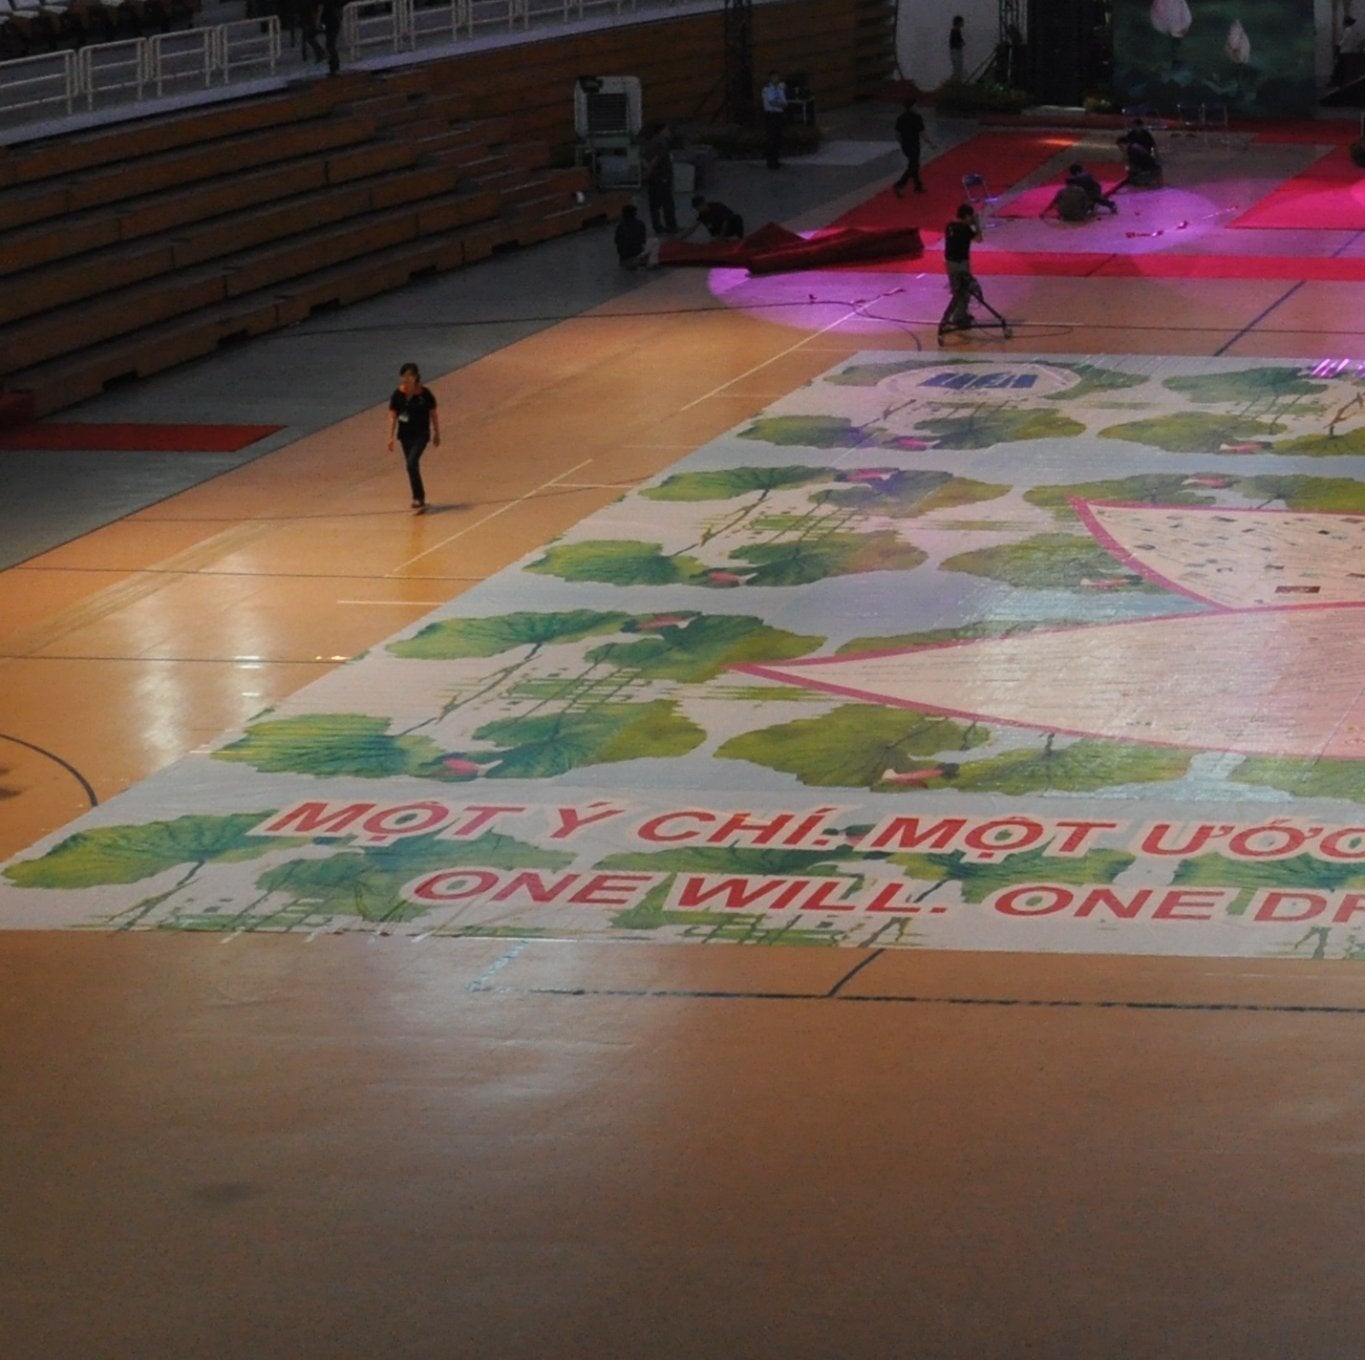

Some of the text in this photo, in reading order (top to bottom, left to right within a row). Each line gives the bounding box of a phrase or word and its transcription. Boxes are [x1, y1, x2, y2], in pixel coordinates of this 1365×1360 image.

[264, 801, 526, 842] MỘT
[550, 801, 625, 839] Ý
[637, 807, 838, 846] CHÍ.
[869, 816, 1118, 859] MỘT
[413, 870, 655, 905] ONE
[677, 877, 947, 914] WILL.
[993, 885, 1225, 921] ONE
